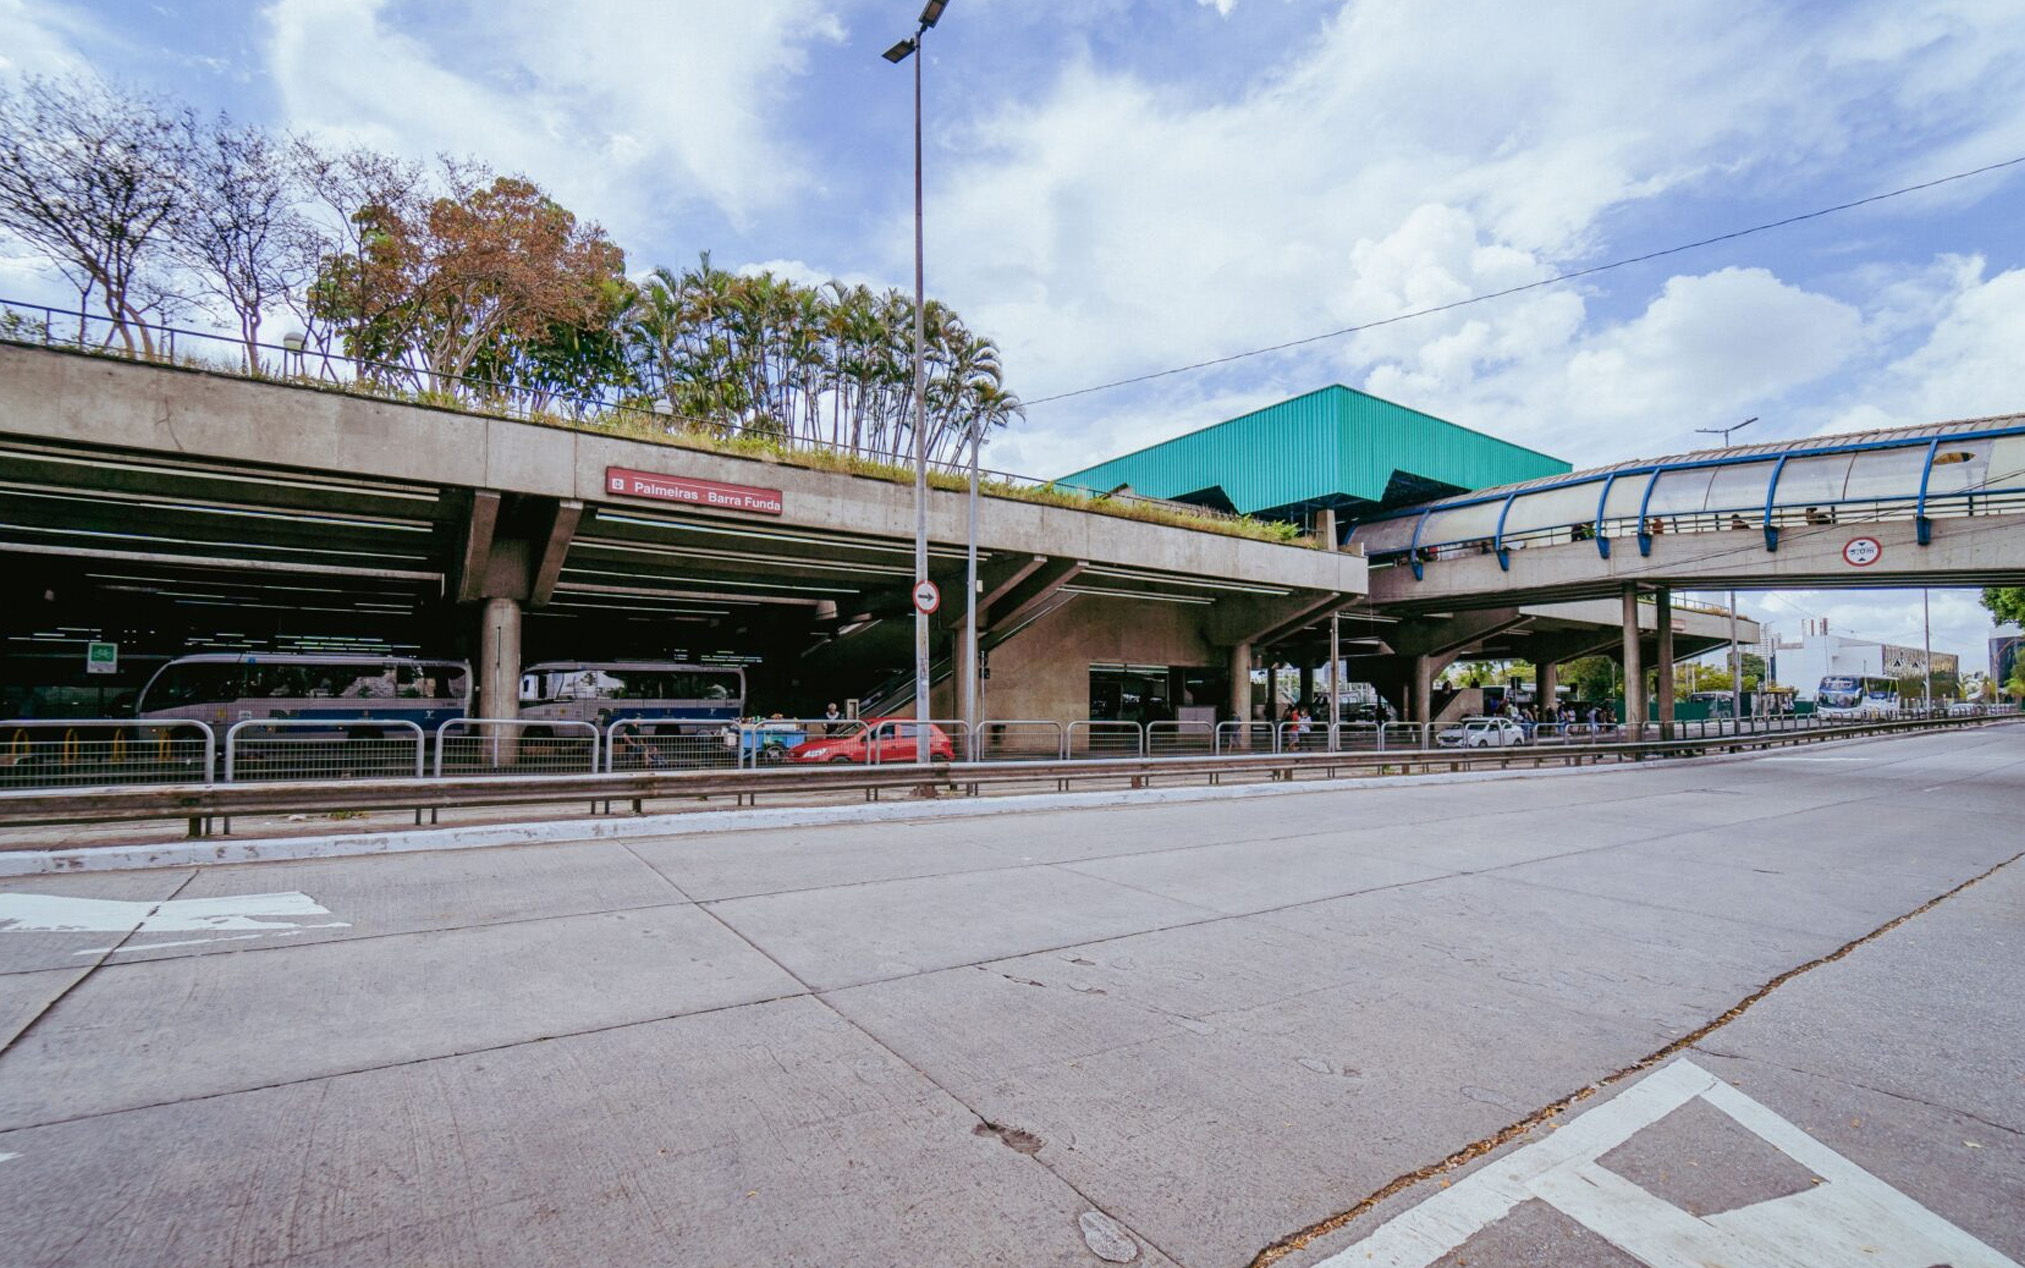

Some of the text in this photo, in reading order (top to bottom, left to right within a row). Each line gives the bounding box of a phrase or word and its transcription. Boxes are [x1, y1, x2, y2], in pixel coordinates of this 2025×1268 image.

[634, 482, 781, 511] Palmeiras Barra Funda
